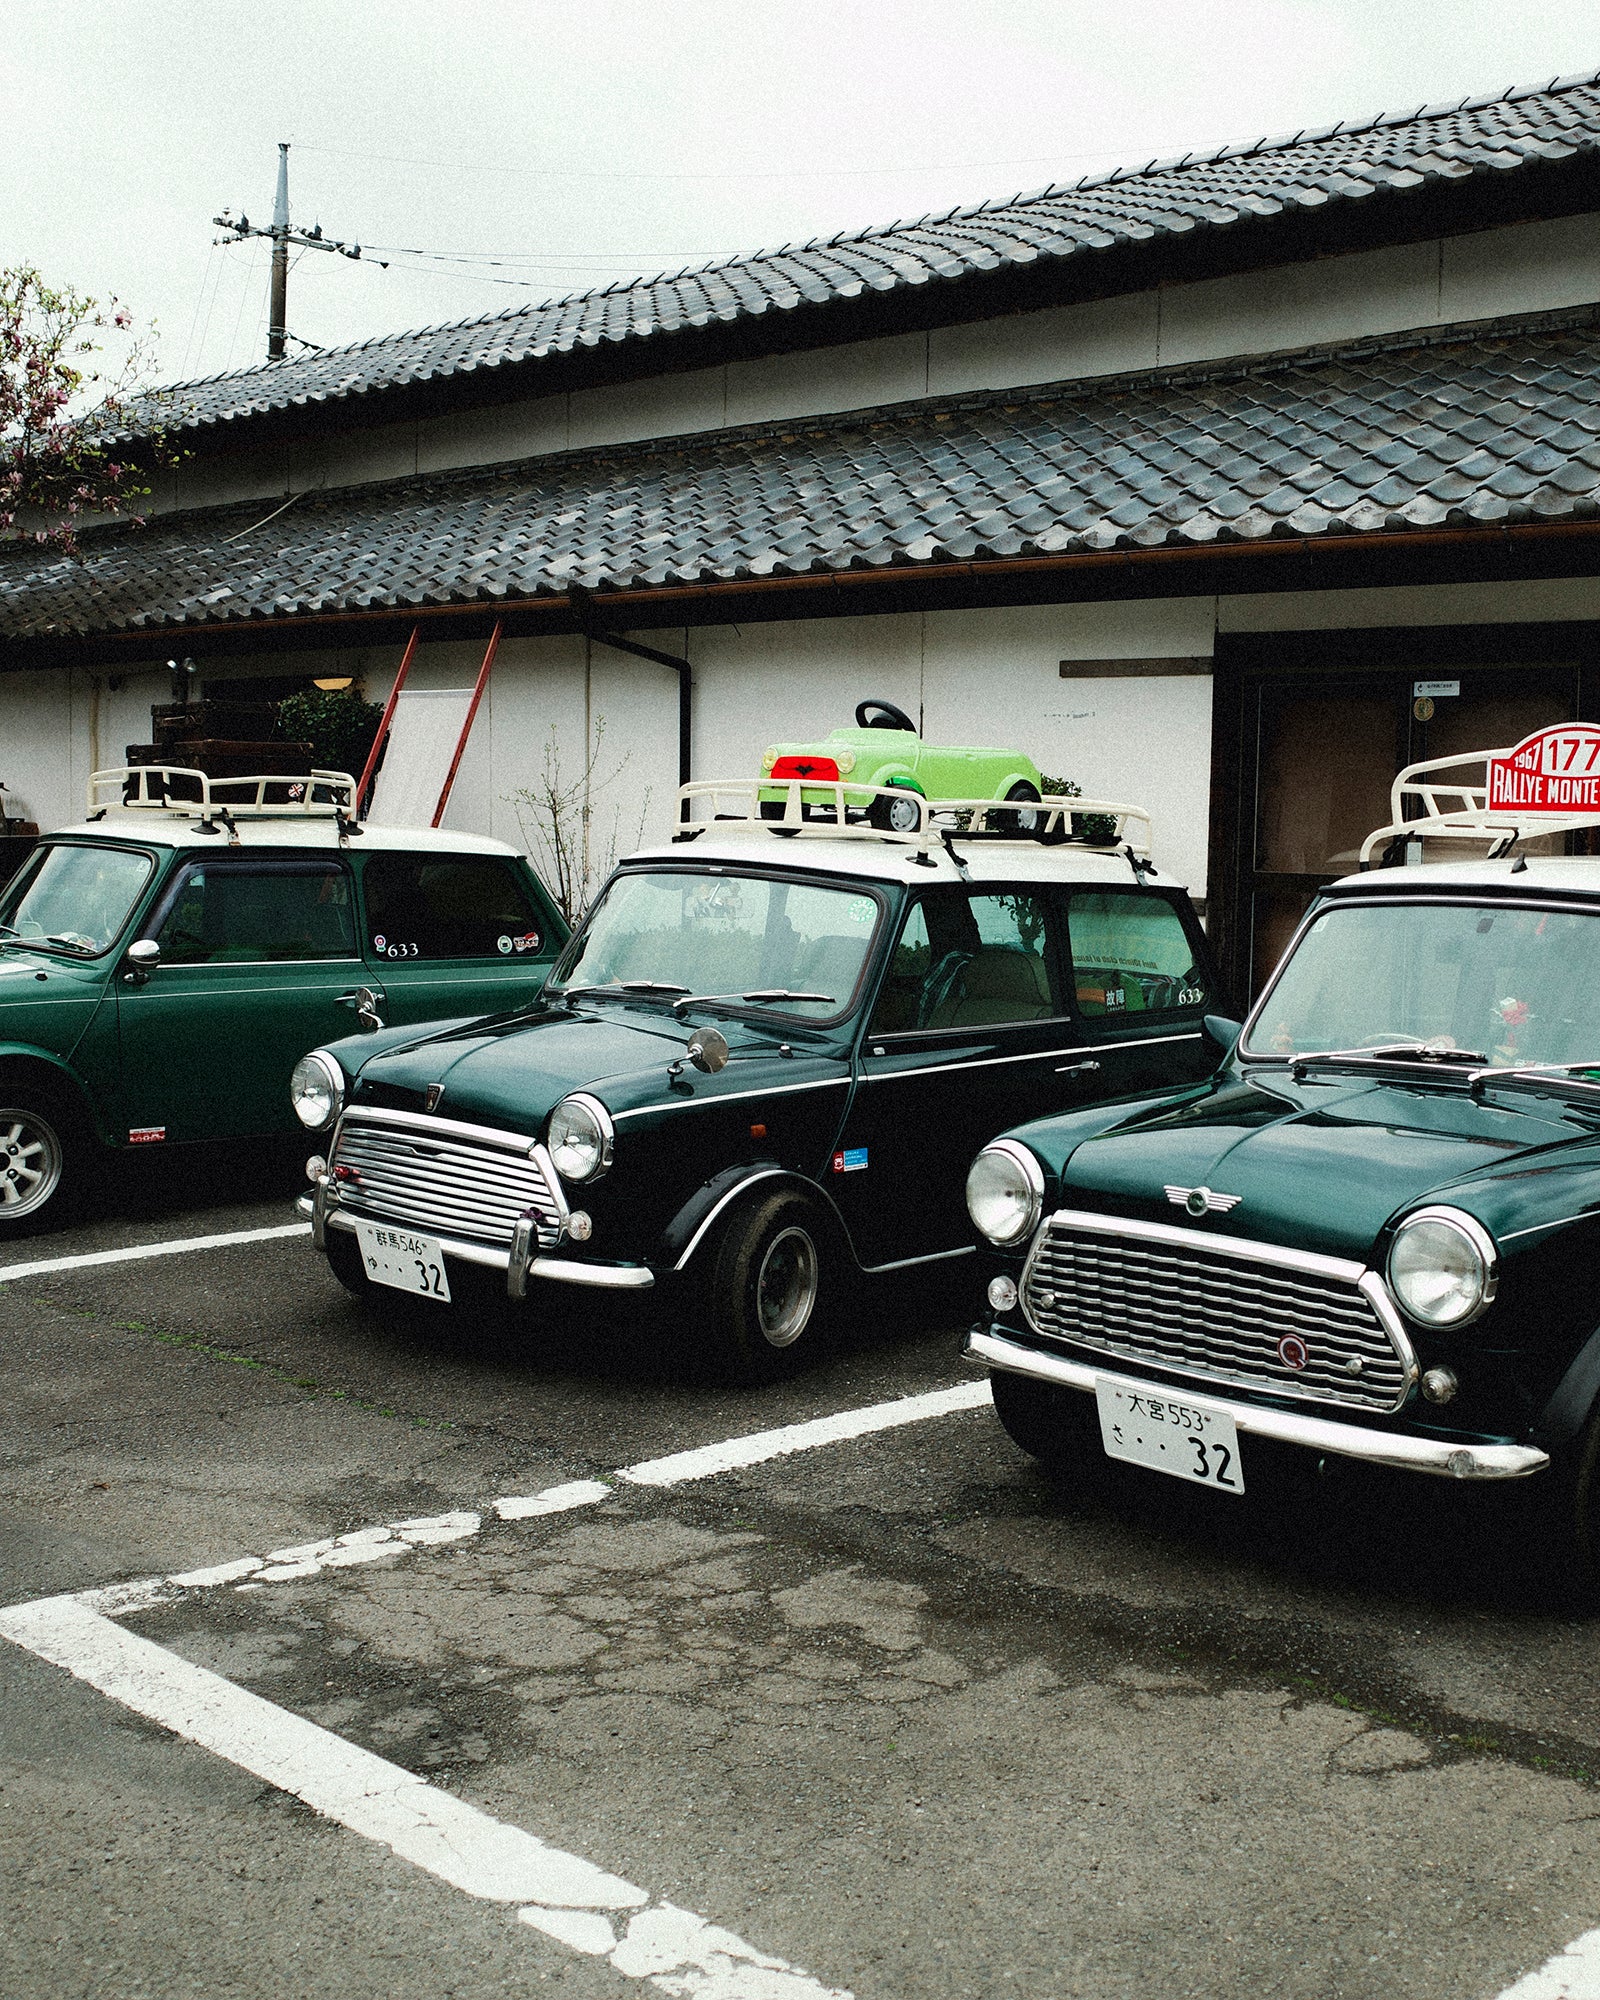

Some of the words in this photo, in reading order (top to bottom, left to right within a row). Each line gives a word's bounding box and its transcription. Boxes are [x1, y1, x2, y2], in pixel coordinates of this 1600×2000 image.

[1514, 741, 1542, 771] 1967
[1548, 739, 1600, 771] 177
[1492, 763, 1544, 804] RALLYE
[387, 942, 419, 958] 633
[1178, 987, 1201, 1005] 633
